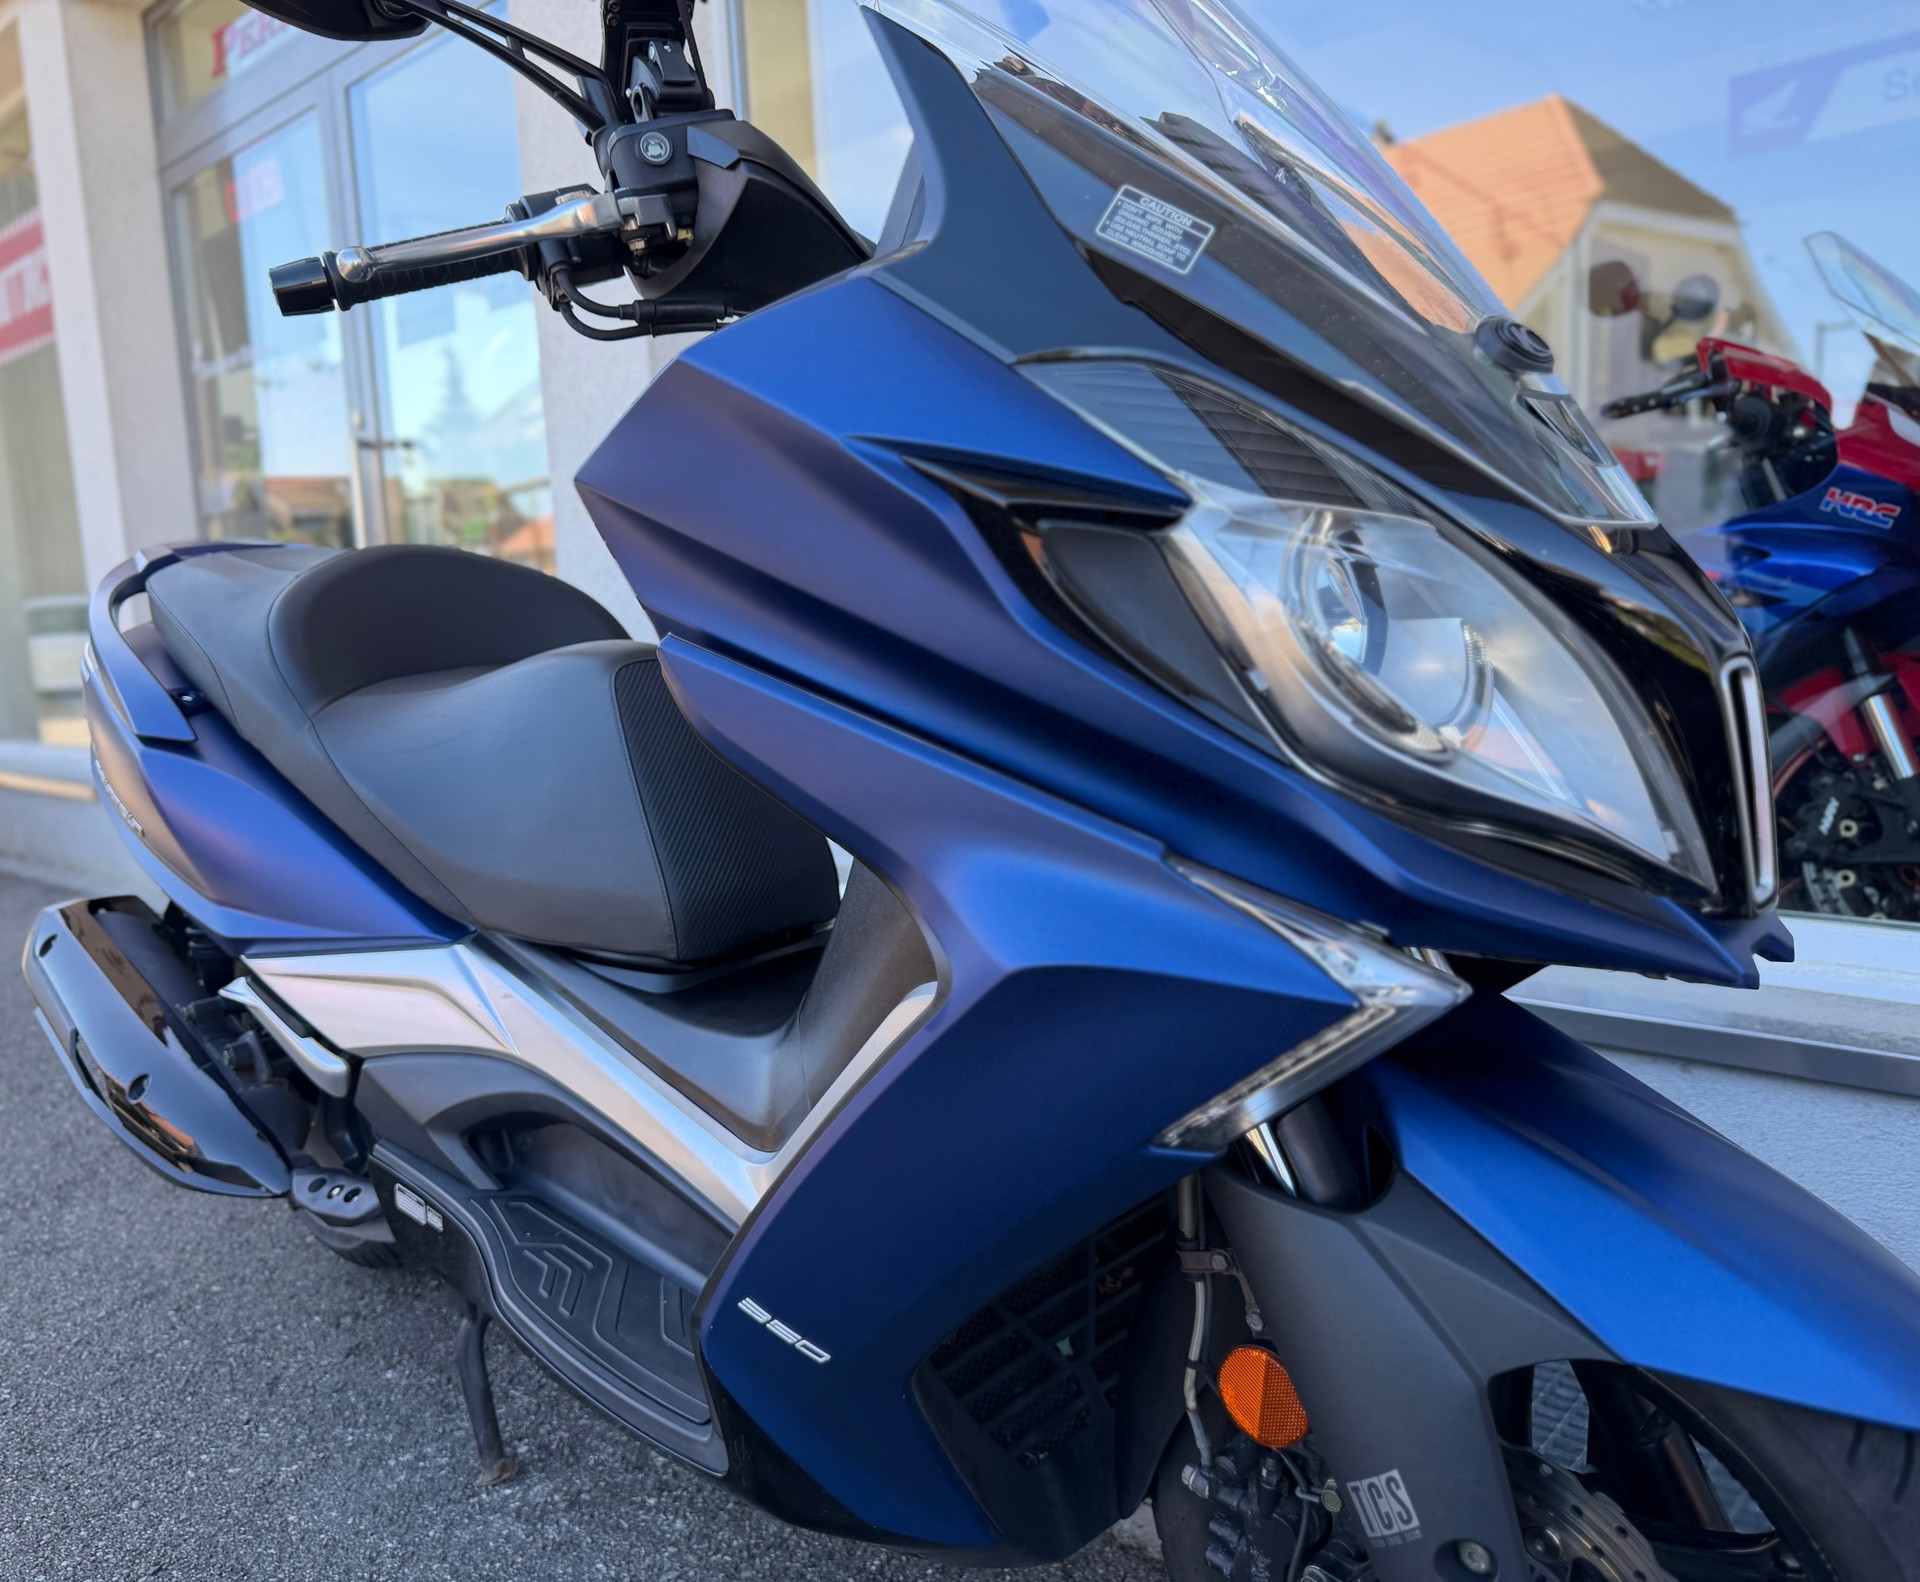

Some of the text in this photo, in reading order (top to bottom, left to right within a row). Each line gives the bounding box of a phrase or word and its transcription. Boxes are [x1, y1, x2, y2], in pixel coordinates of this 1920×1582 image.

[1118, 208, 1182, 242] ORGANIC SOLVENT
[1122, 202, 1183, 235] DON'T WIPE WITH
[1140, 197, 1193, 227] CAUTION
[1106, 228, 1130, 243] CLEAN
[1110, 221, 1187, 262] USE NEUTRAL SOAP TO
[1819, 486, 1902, 529] HRC
[737, 1297, 831, 1363] 350
[1348, 1473, 1415, 1534] TCS
